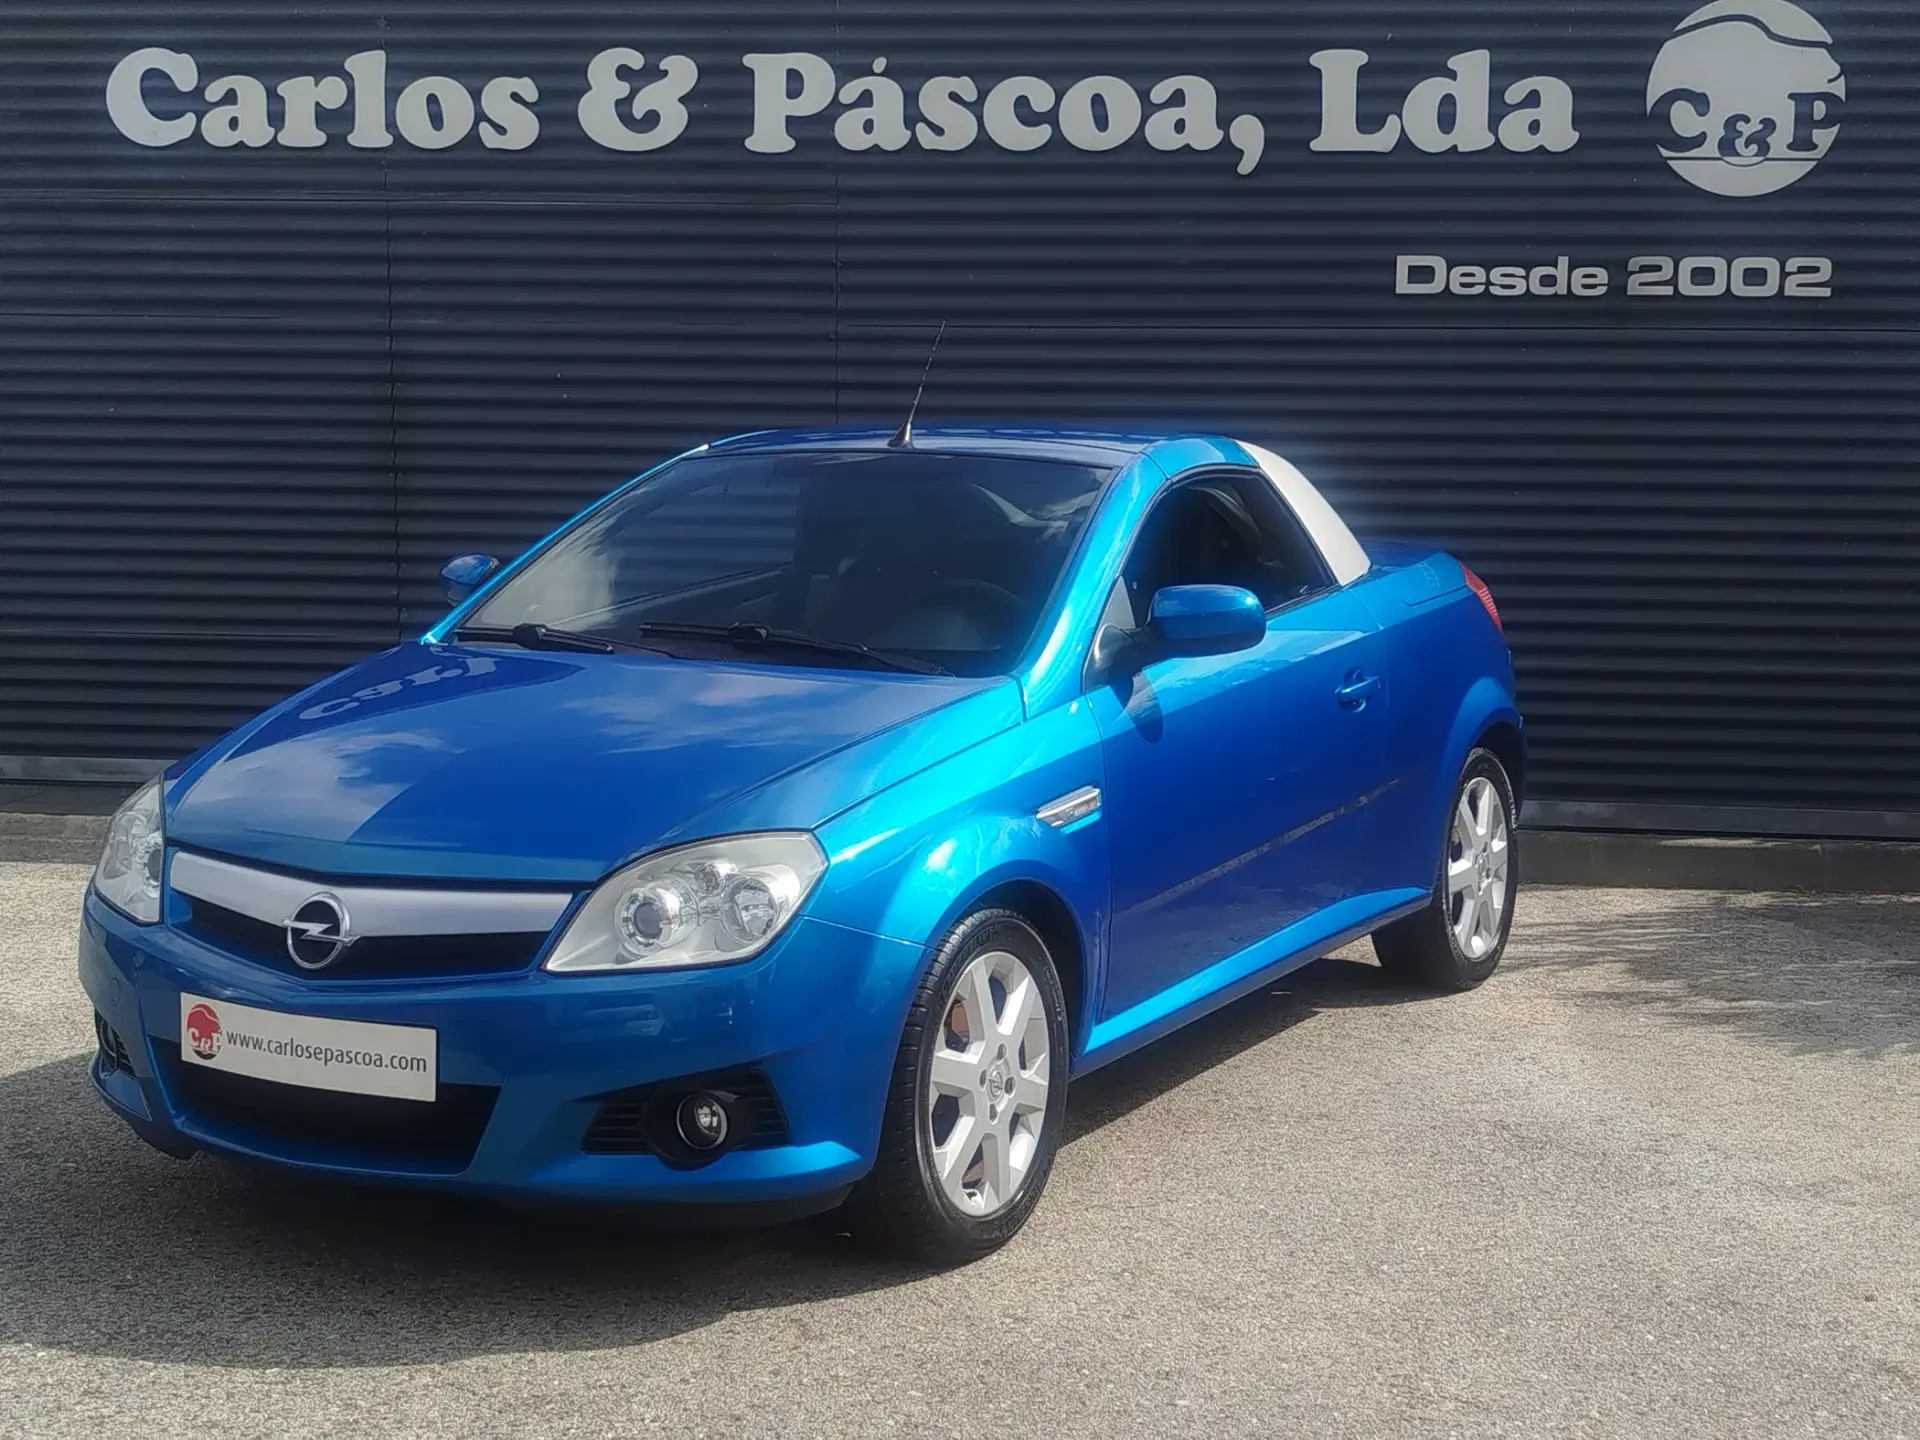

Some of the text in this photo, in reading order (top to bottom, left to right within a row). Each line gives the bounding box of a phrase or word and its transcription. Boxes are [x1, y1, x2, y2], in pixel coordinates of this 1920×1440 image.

[106, 47, 1580, 175] Carlos & Páscoa, Lda
[1395, 254, 1833, 298] Desde 2002
[226, 1030, 427, 1072] www.carlosepascoa.com
